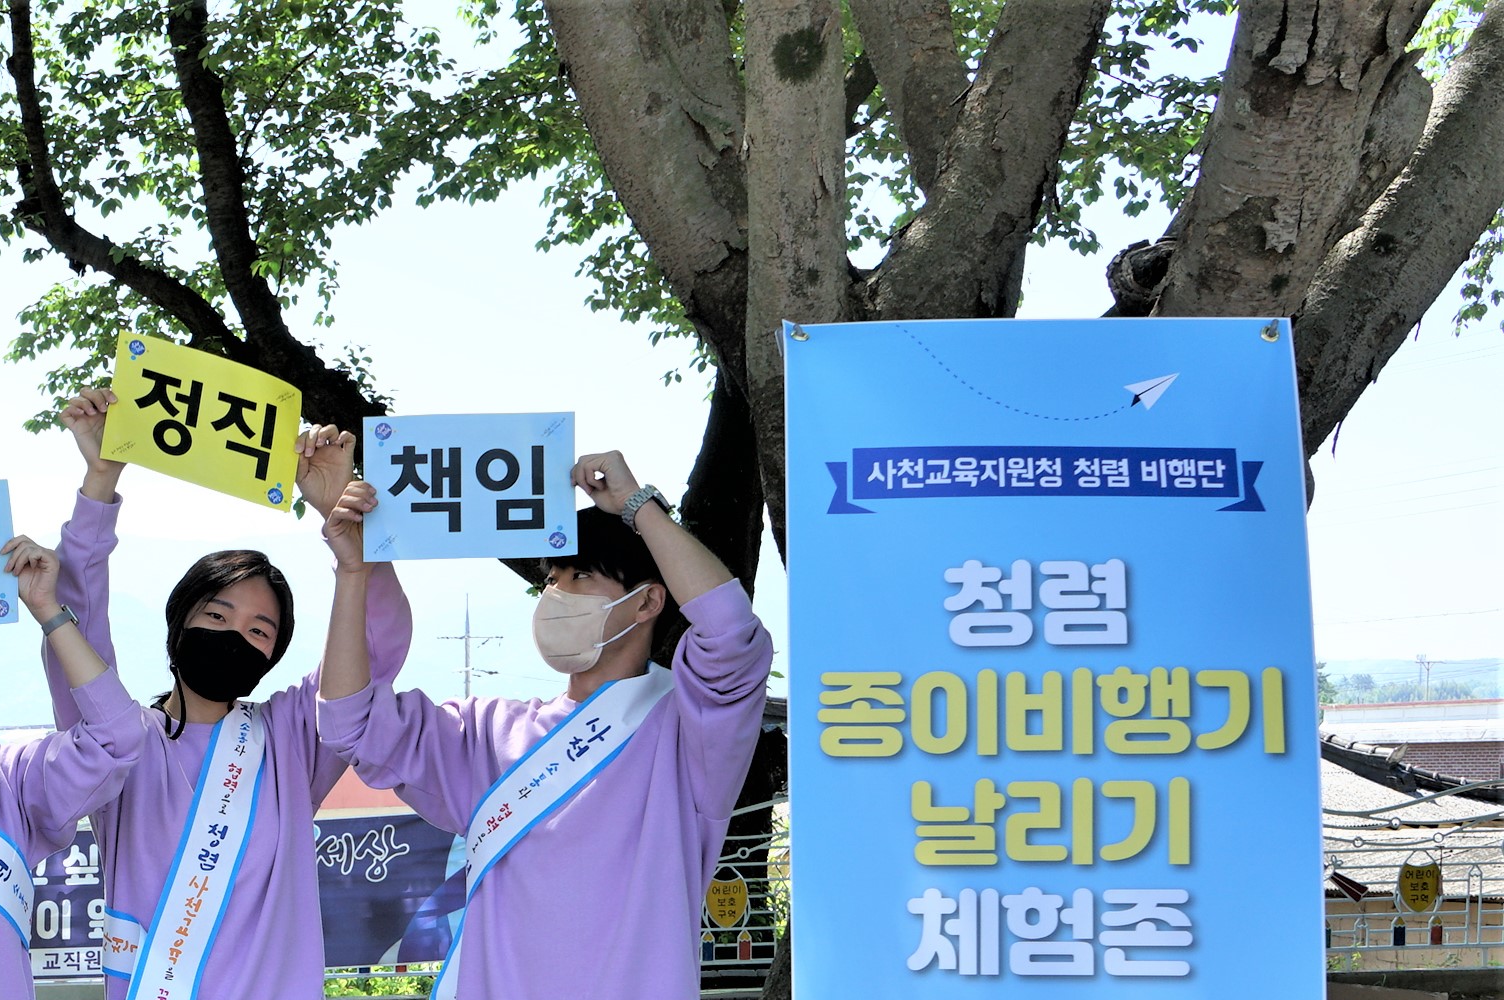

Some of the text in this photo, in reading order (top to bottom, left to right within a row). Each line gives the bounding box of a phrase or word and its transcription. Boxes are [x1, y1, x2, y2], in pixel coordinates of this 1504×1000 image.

[134, 368, 277, 481] 정직
[388, 445, 545, 532] 책임
[867, 457, 1226, 489] 사천교육지원청 청렴 비행단
[943, 558, 1128, 647] 청렴
[817, 666, 1285, 757] 종이비행기
[567, 718, 611, 761] 사천
[911, 776, 1191, 866] 날리기
[198, 823, 229, 871] 청렴
[711, 886, 741, 895] 어린이
[1405, 870, 1435, 880] 어린이
[1410, 882, 1429, 891] 보호
[717, 898, 736, 907] 보호
[718, 910, 736, 918] 구역
[1410, 894, 1429, 903] 구역
[906, 886, 1193, 976] 체험존
